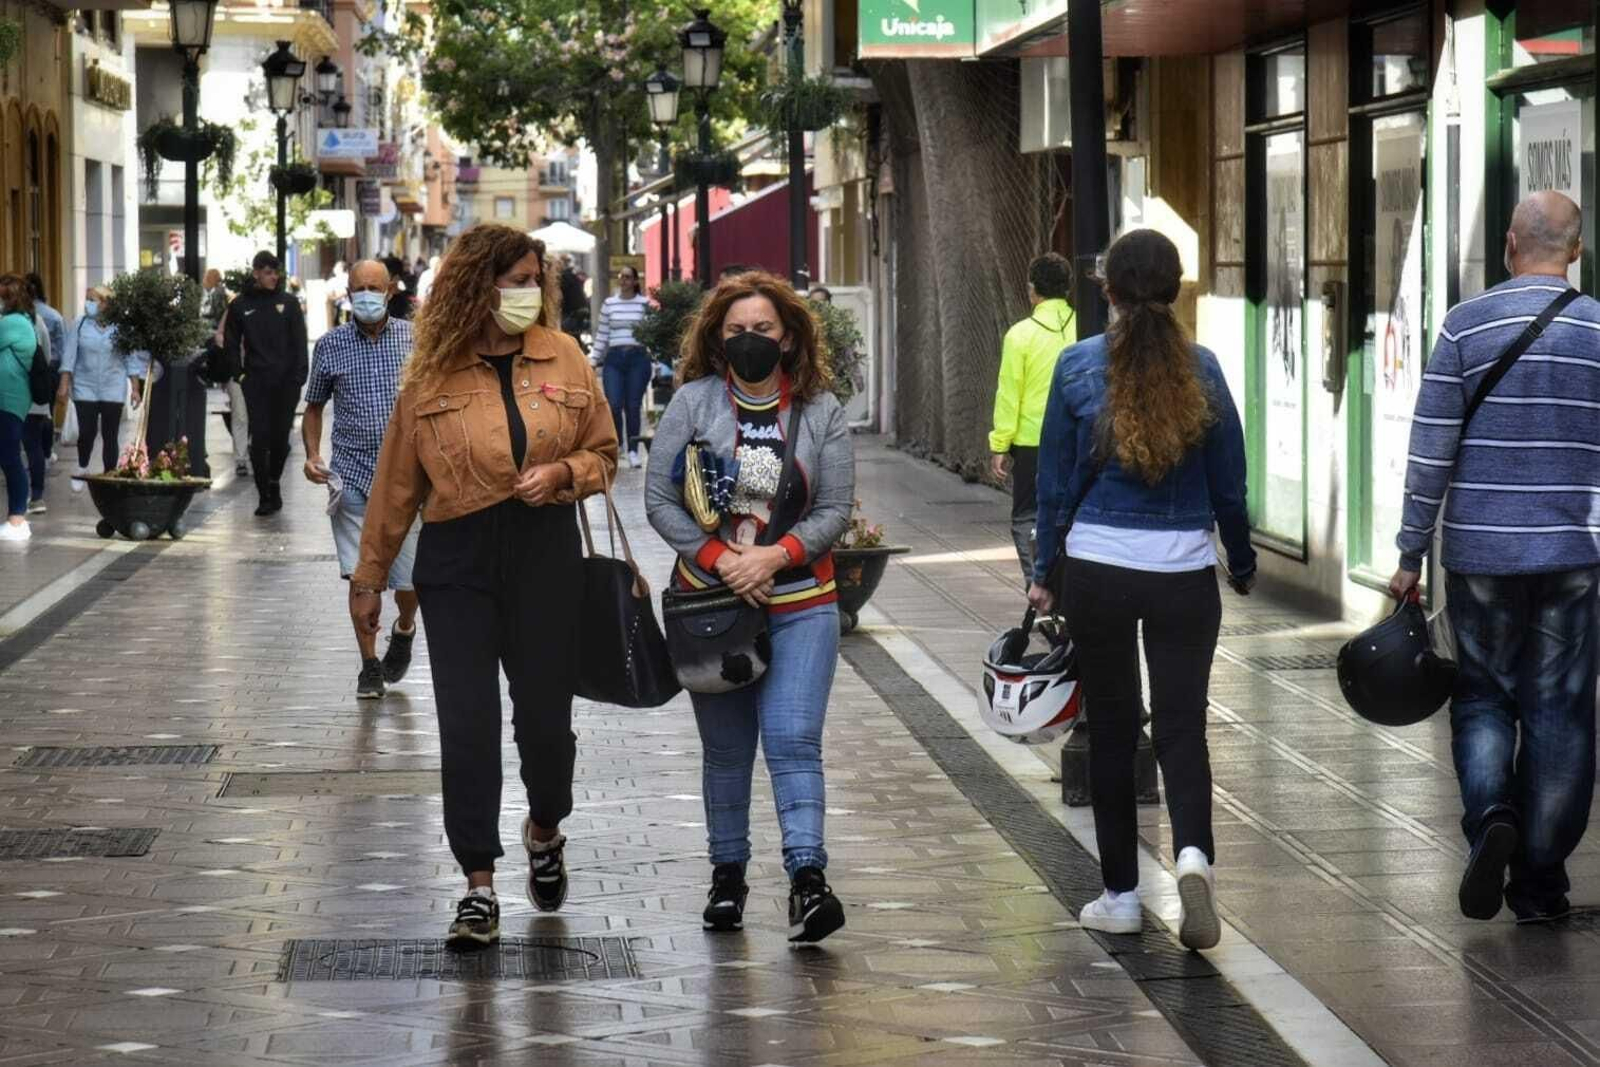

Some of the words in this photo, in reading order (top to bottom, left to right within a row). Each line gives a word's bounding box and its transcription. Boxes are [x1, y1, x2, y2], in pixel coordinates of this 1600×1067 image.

[881, 15, 955, 40] Unicaja
[1528, 139, 1553, 191] SOMOS
[1554, 128, 1572, 190] MÁS
